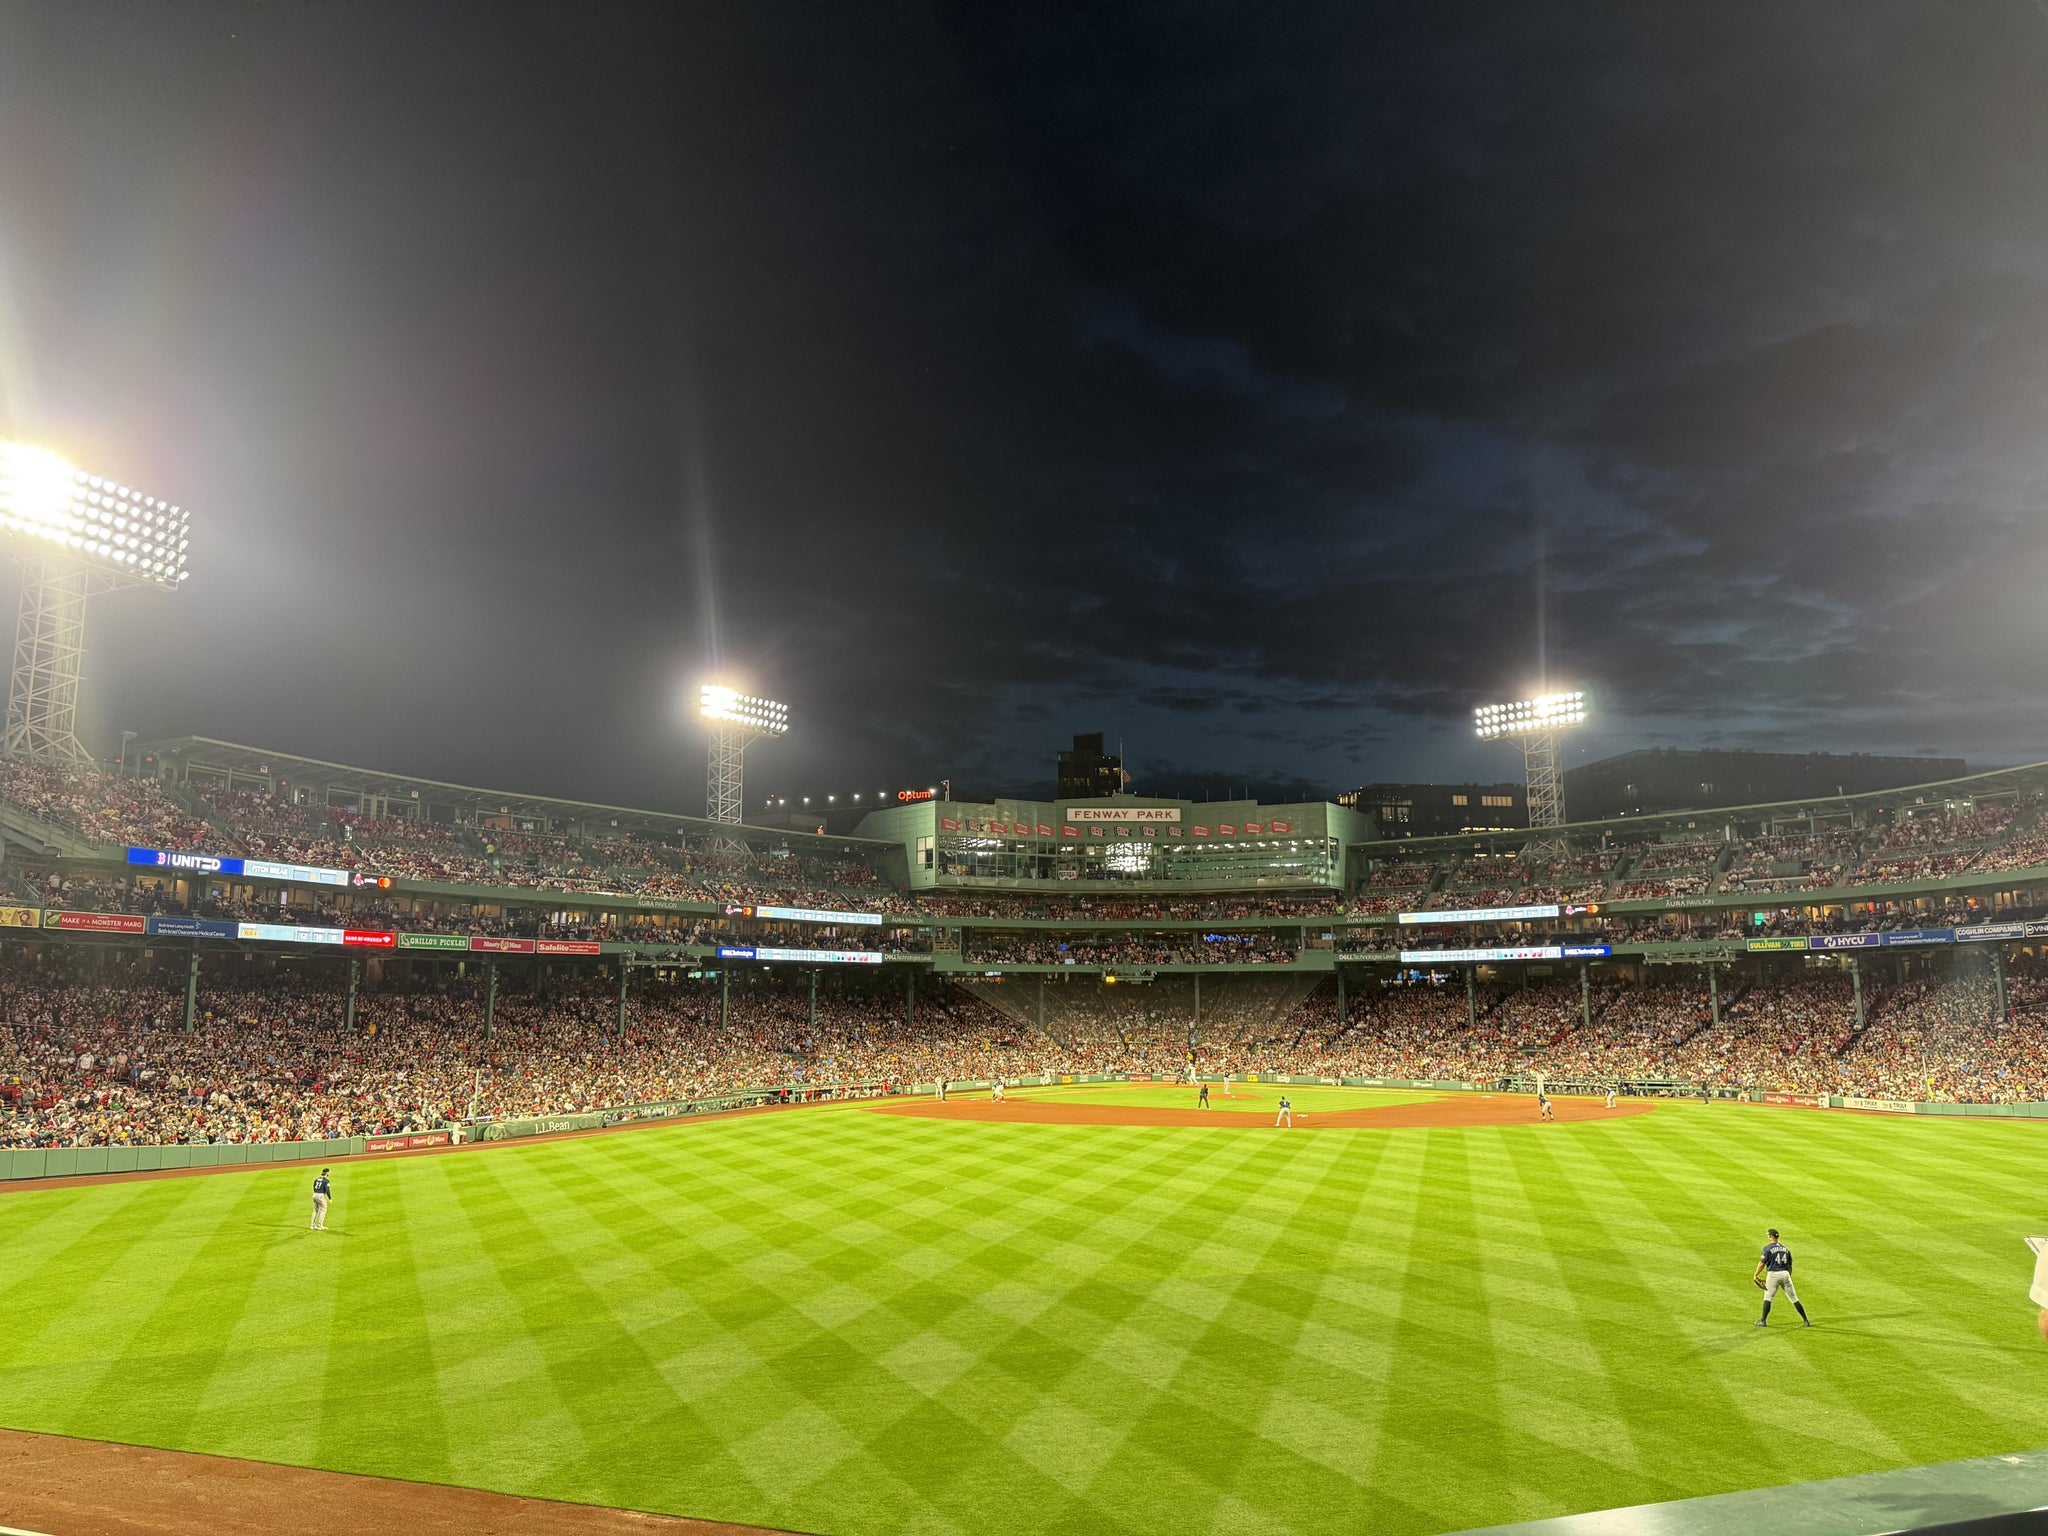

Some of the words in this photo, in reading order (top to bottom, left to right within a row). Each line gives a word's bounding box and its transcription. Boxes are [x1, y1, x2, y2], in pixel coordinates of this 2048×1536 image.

[898, 790, 931, 802] Optum
[1074, 811, 1129, 819] FENWAY
[1137, 811, 1173, 819] PARK
[172, 854, 221, 871] UNITED
[92, 918, 121, 927] MONSTER
[1984, 925, 2021, 934] COMPANIES
[410, 937, 437, 946] GRILLO'S
[440, 939, 466, 947] PICKLES
[483, 940, 499, 949] Ninety
[1750, 940, 1780, 949] SULLIVAN
[1838, 937, 1865, 946] HYCU
[540, 943, 569, 951] Safelite
[1775, 1253, 1787, 1264] 44
